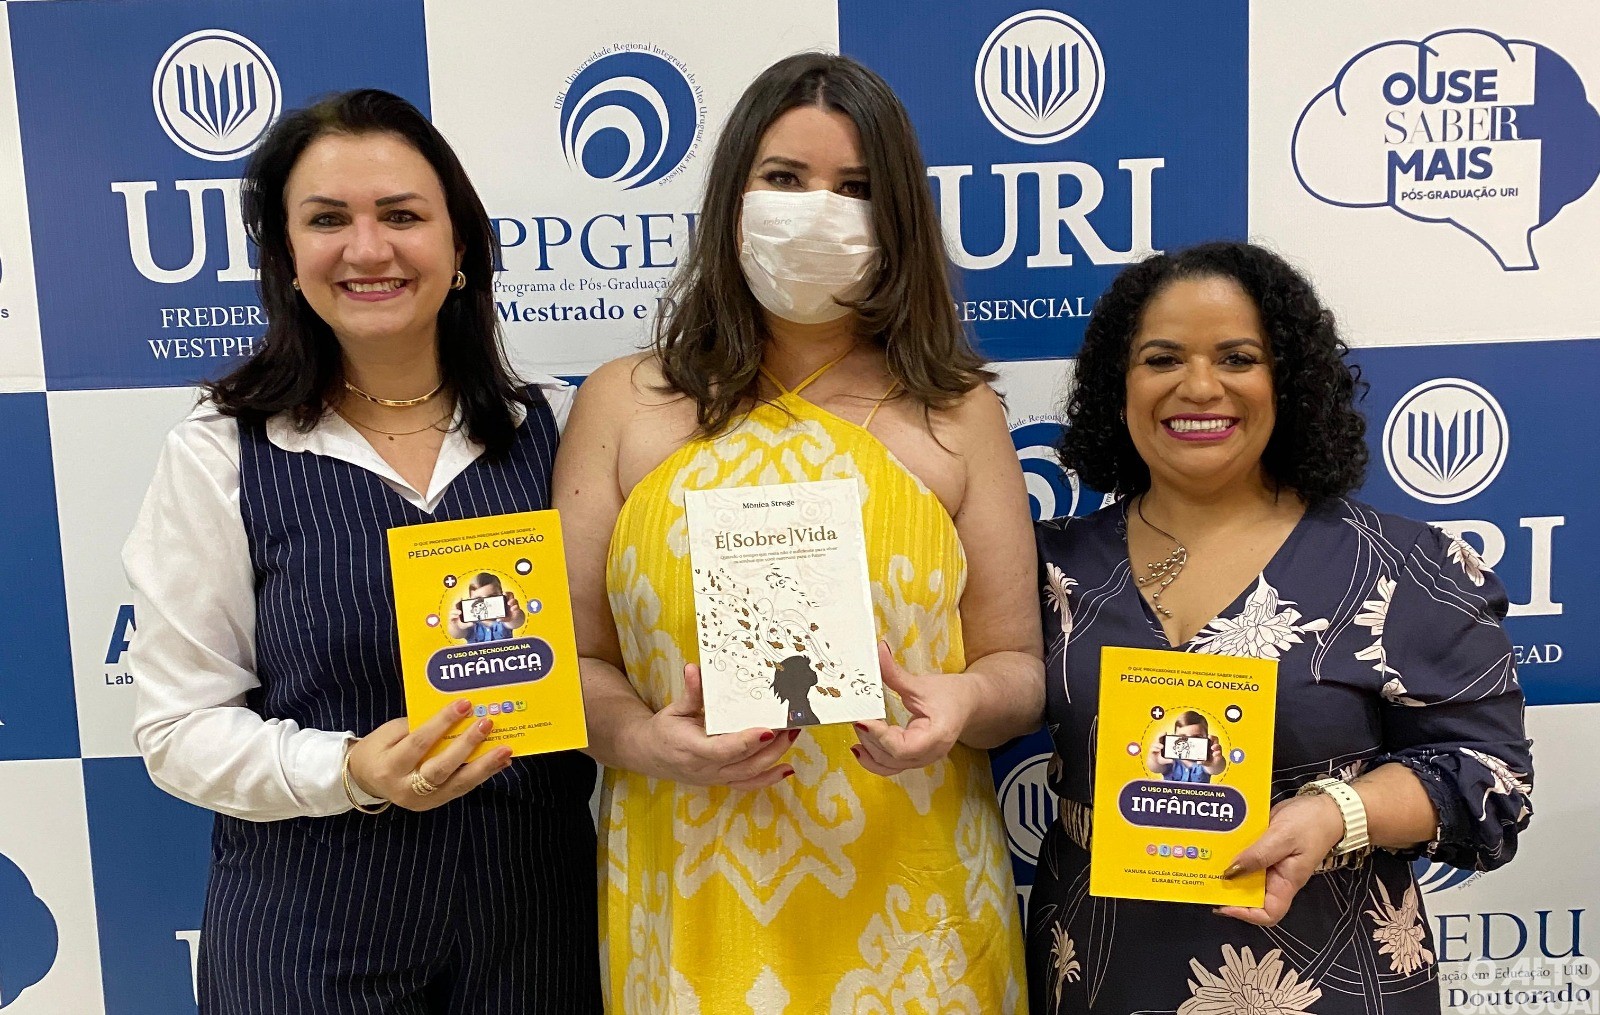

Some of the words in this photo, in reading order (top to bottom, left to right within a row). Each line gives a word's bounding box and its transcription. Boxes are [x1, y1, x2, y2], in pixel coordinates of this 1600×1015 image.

[613, 42, 651, 53] Regional
[565, 46, 611, 85] Universidade
[652, 44, 688, 74] Integrada
[686, 73, 696, 84] do
[1382, 68, 1498, 106] OUSE
[694, 85, 704, 104] Alto
[1384, 105, 1522, 145] SABER
[684, 150, 697, 163] das
[1387, 146, 1493, 182] MAIS
[1401, 186, 1497, 201] PÓS-GRADUAÇÃO
[1500, 187, 1519, 197] URI
[926, 157, 1165, 270] URI
[494, 280, 556, 297] Programa
[560, 278, 575, 291] de
[495, 297, 624, 322] Mestrado
[633, 304, 647, 319] e
[147, 336, 257, 360] WESTPH
[408, 543, 472, 559] PEDAGOGIA
[474, 541, 490, 550] DA
[492, 533, 545, 548] CONEXÃO
[479, 645, 520, 655] TECNOLOGIA
[1120, 673, 1185, 687] PEDAGOGIA
[1187, 679, 1204, 688] DA
[1206, 681, 1260, 692] CONEXÃO
[1173, 788, 1215, 797] TECNOLOGIA
[1471, 971, 1490, 980] em
[1495, 966, 1551, 983] Educação
[1563, 963, 1589, 977] URI
[1448, 982, 1591, 1008] Doutorado
